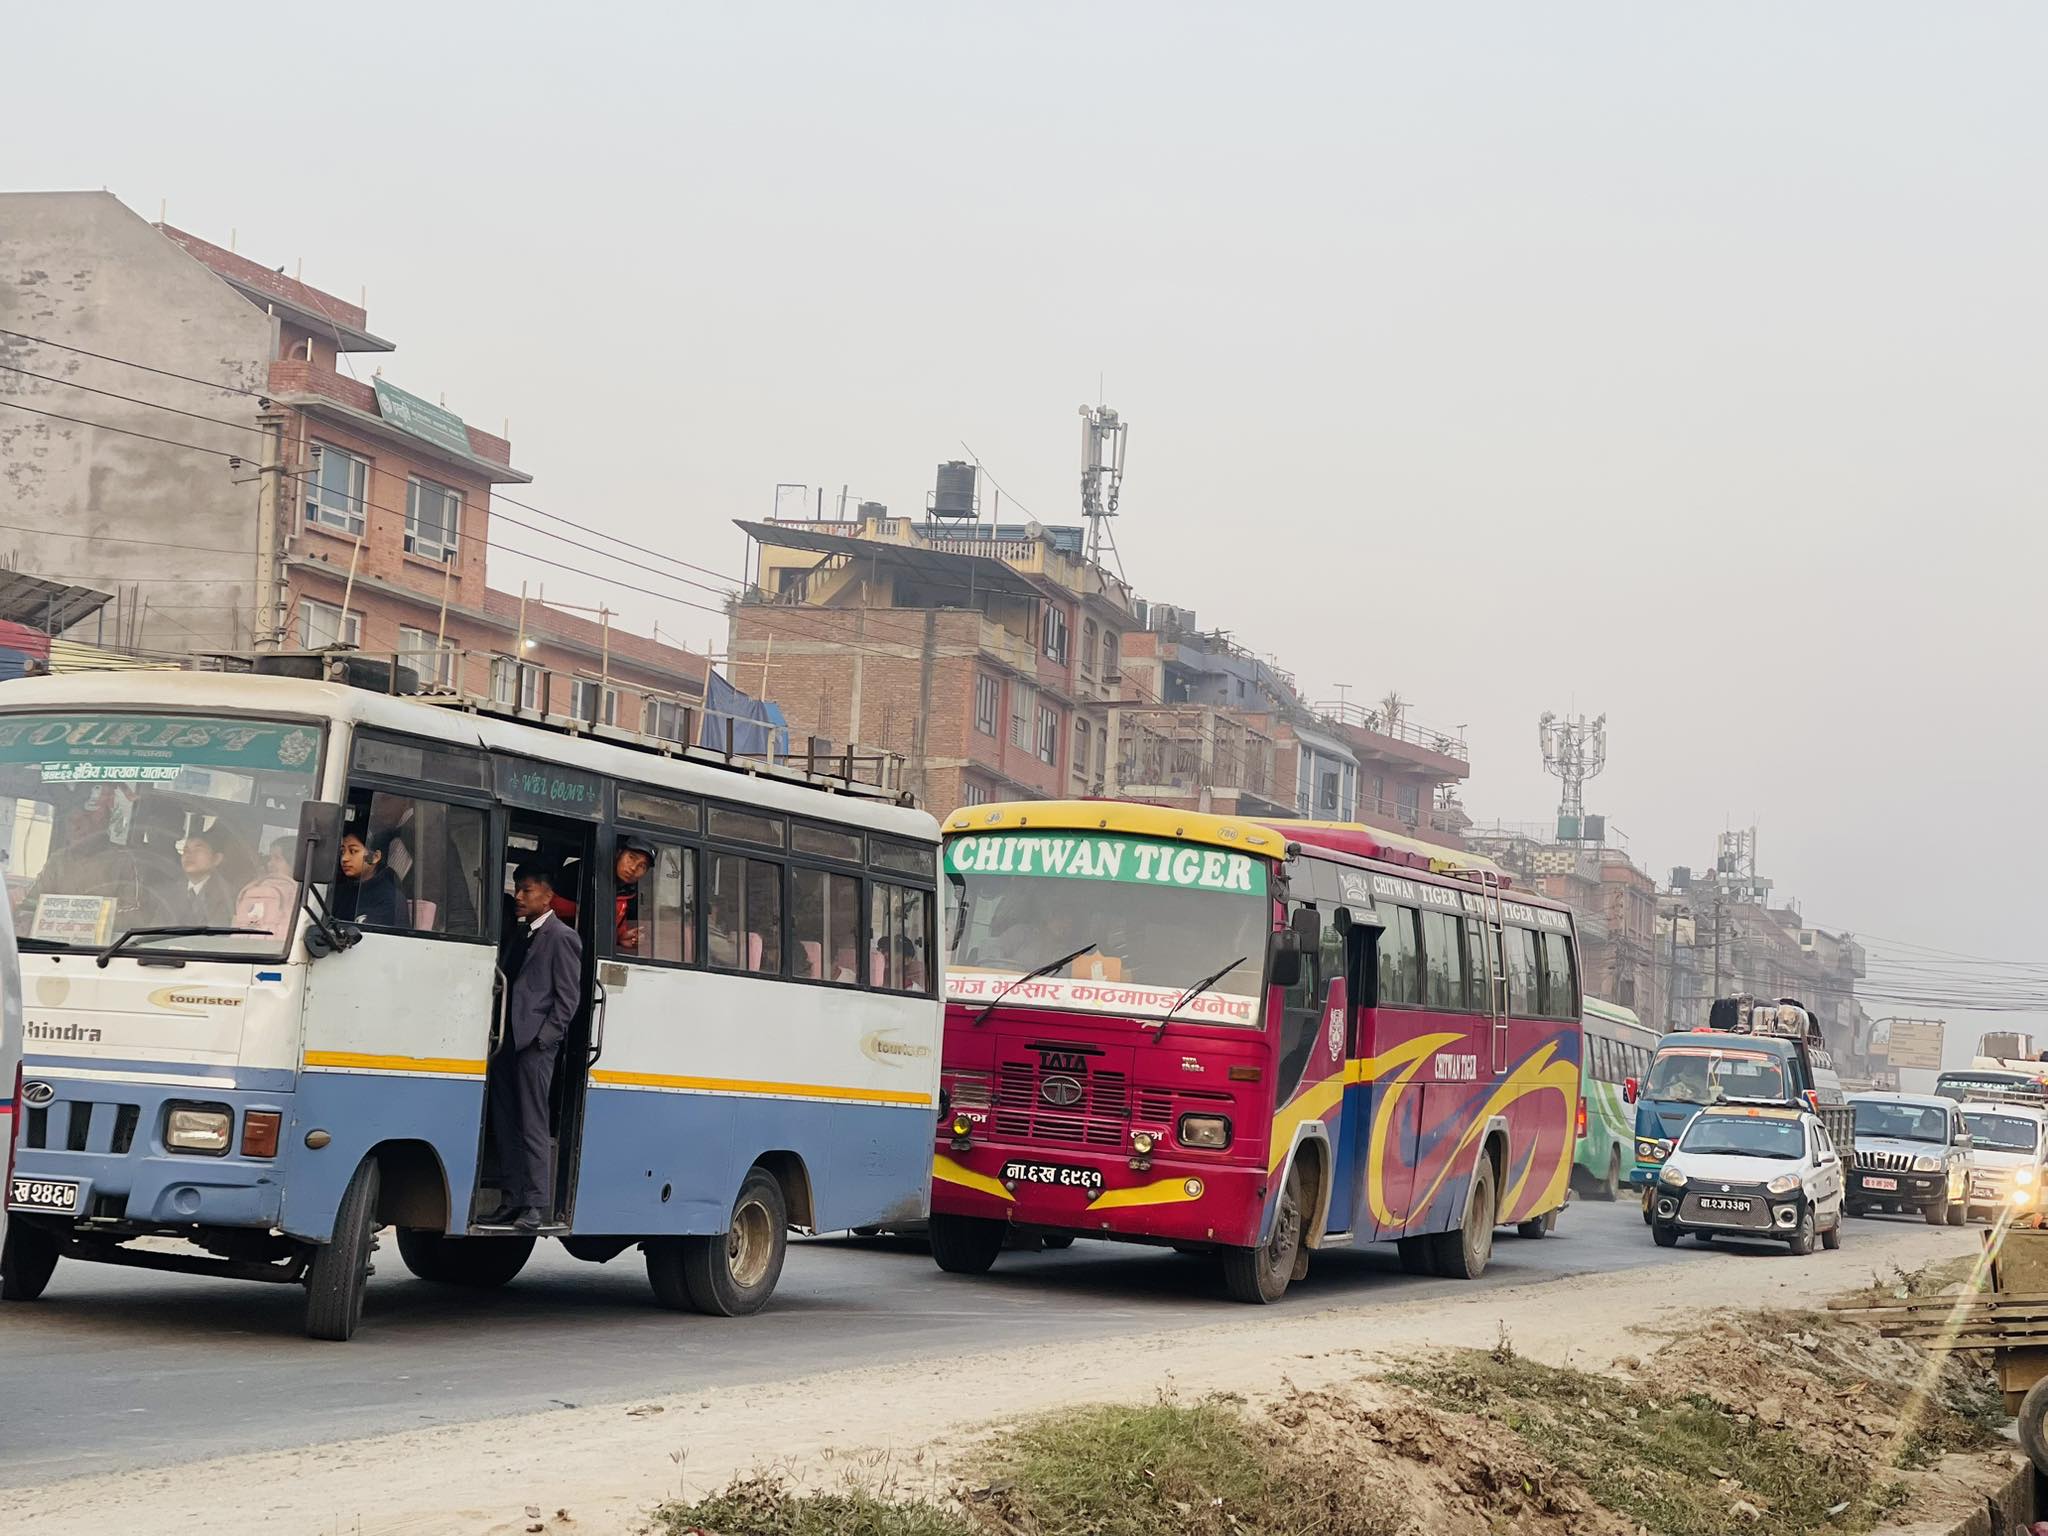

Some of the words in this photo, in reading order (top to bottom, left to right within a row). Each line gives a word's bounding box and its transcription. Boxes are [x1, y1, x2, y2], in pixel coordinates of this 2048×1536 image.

[953, 836, 1125, 877] CHITWAN
[1134, 845, 1252, 890] TIGER
[1373, 875, 1415, 899] CHITWAN
[1420, 885, 1458, 907] TIGER
[1462, 893, 1498, 916] CHITAN
[1502, 902, 1535, 923] TIGER
[945, 977, 986, 994] गंज
[169, 993, 241, 1007] tourister
[22, 1021, 102, 1042] hindra
[1039, 1051, 1088, 1073] TATA
[1435, 1053, 1461, 1079] CHITWAN
